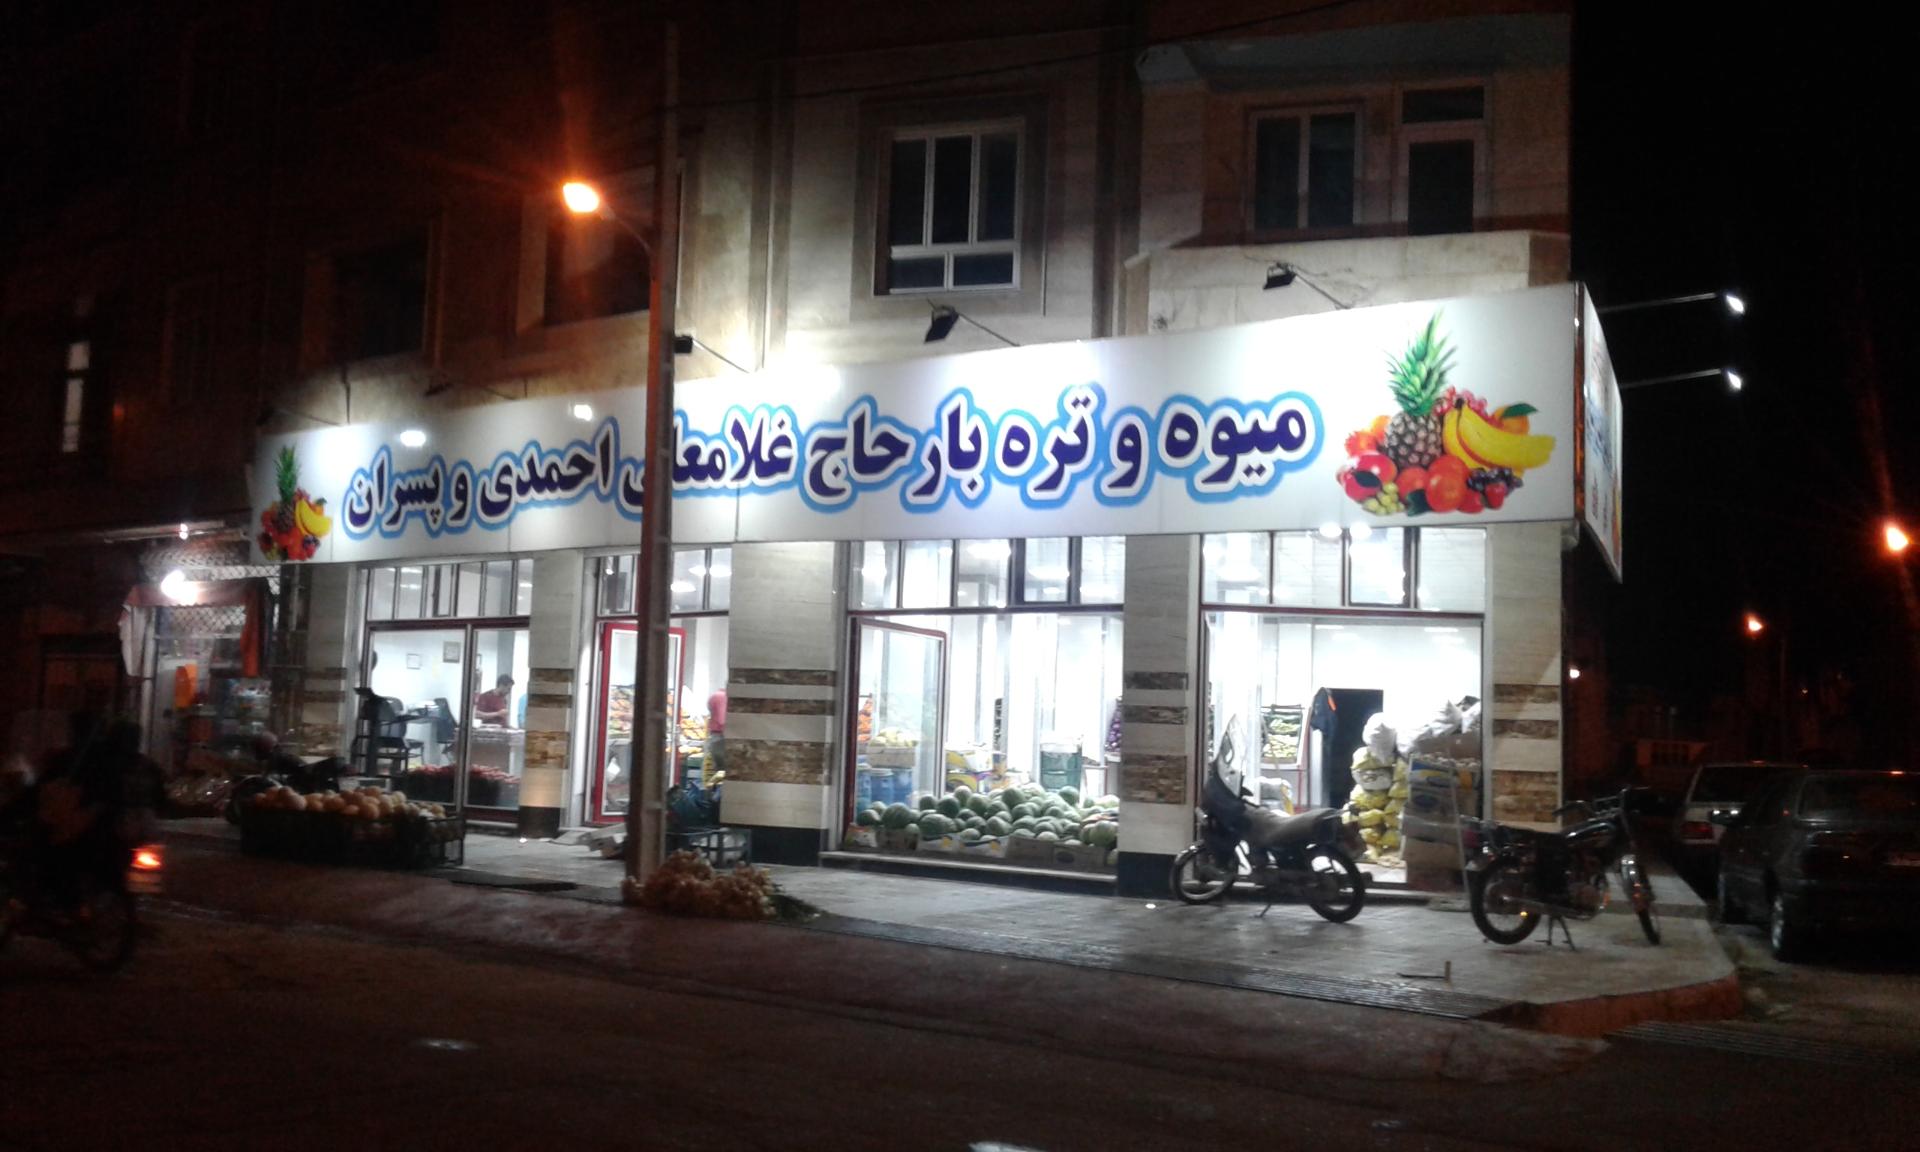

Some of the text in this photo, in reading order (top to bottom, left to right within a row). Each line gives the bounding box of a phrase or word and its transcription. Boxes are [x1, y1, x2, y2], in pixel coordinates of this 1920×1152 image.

[477, 427, 614, 520] احمدی
[807, 410, 912, 499] حاج
[910, 400, 984, 496] بار
[1000, 394, 1093, 493] تره
[1104, 418, 1146, 493] و
[1163, 409, 1308, 486] میوه
[346, 458, 443, 529] پسران
[447, 469, 472, 526] و
